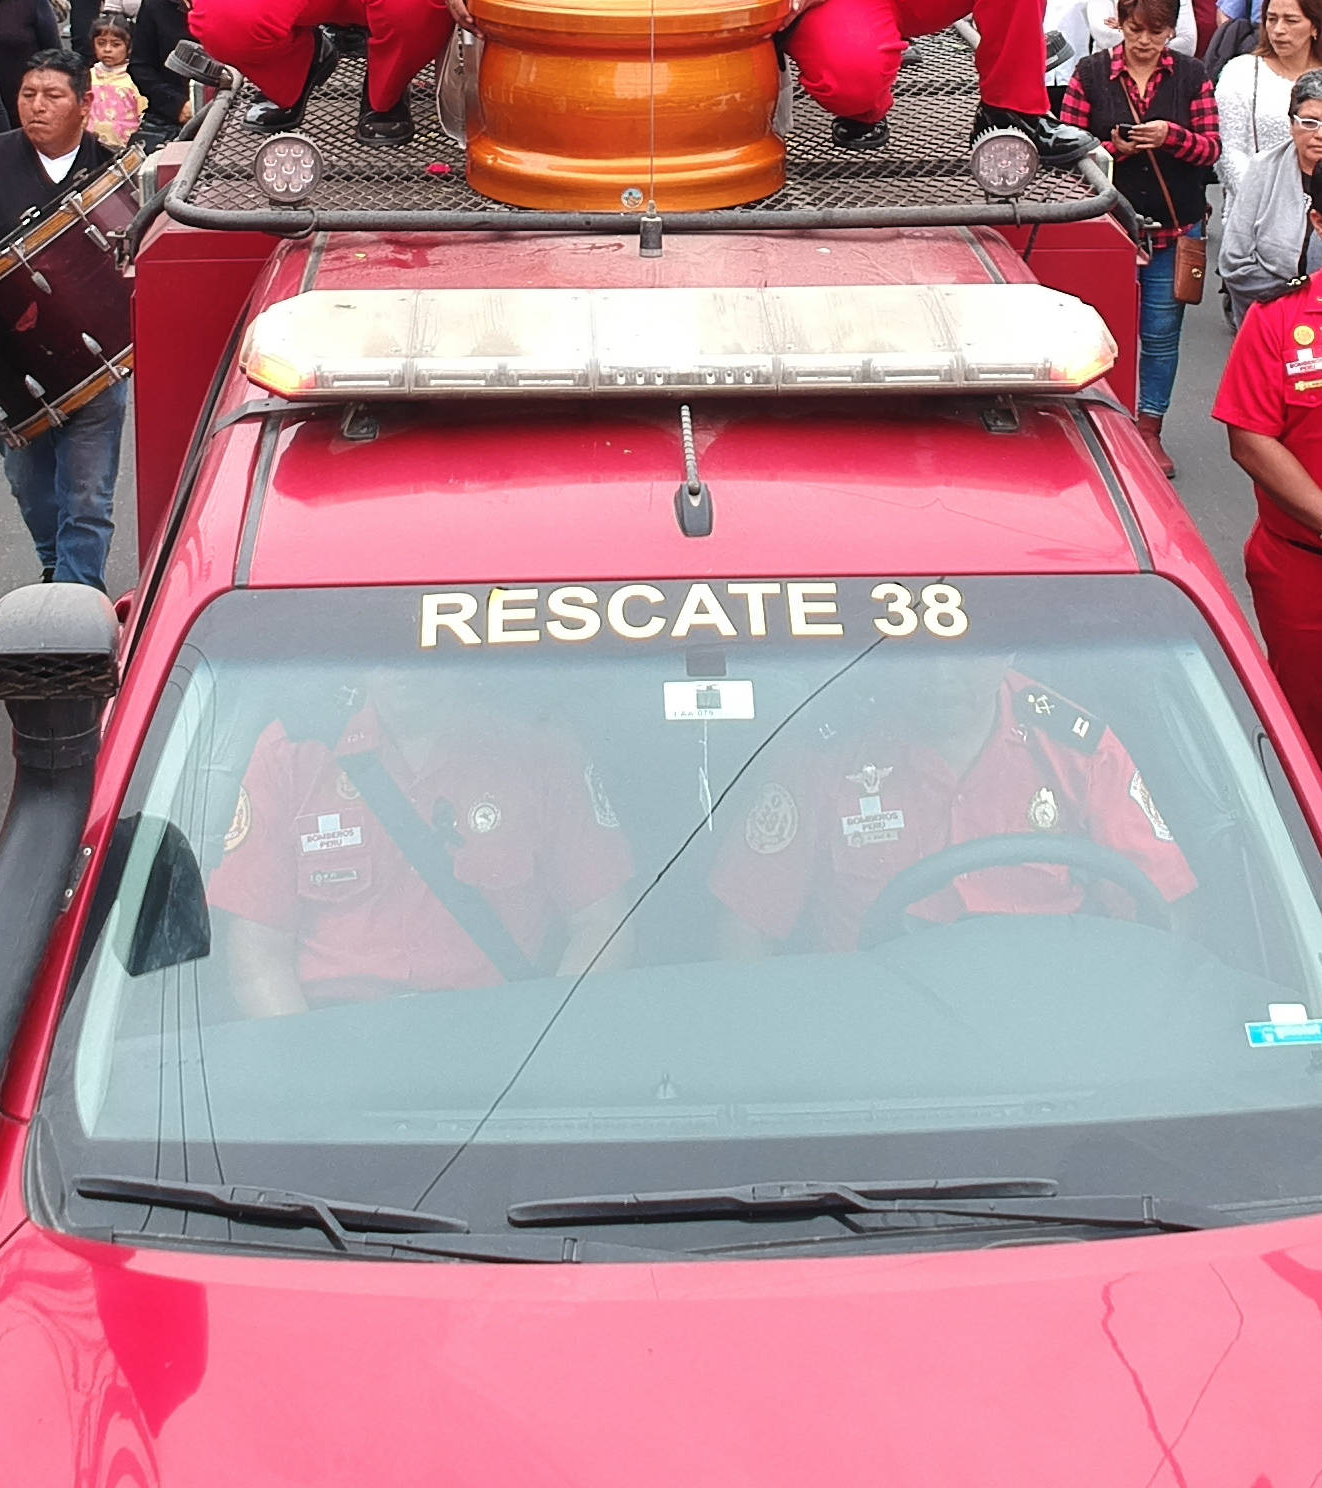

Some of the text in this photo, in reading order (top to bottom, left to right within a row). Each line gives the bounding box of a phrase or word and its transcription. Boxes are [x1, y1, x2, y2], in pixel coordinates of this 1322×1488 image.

[420, 582, 969, 649] RESCATE 38
[847, 812, 898, 826] BOMBEROS
[307, 829, 354, 844] BOMBEROS
[320, 839, 342, 849] PERU
